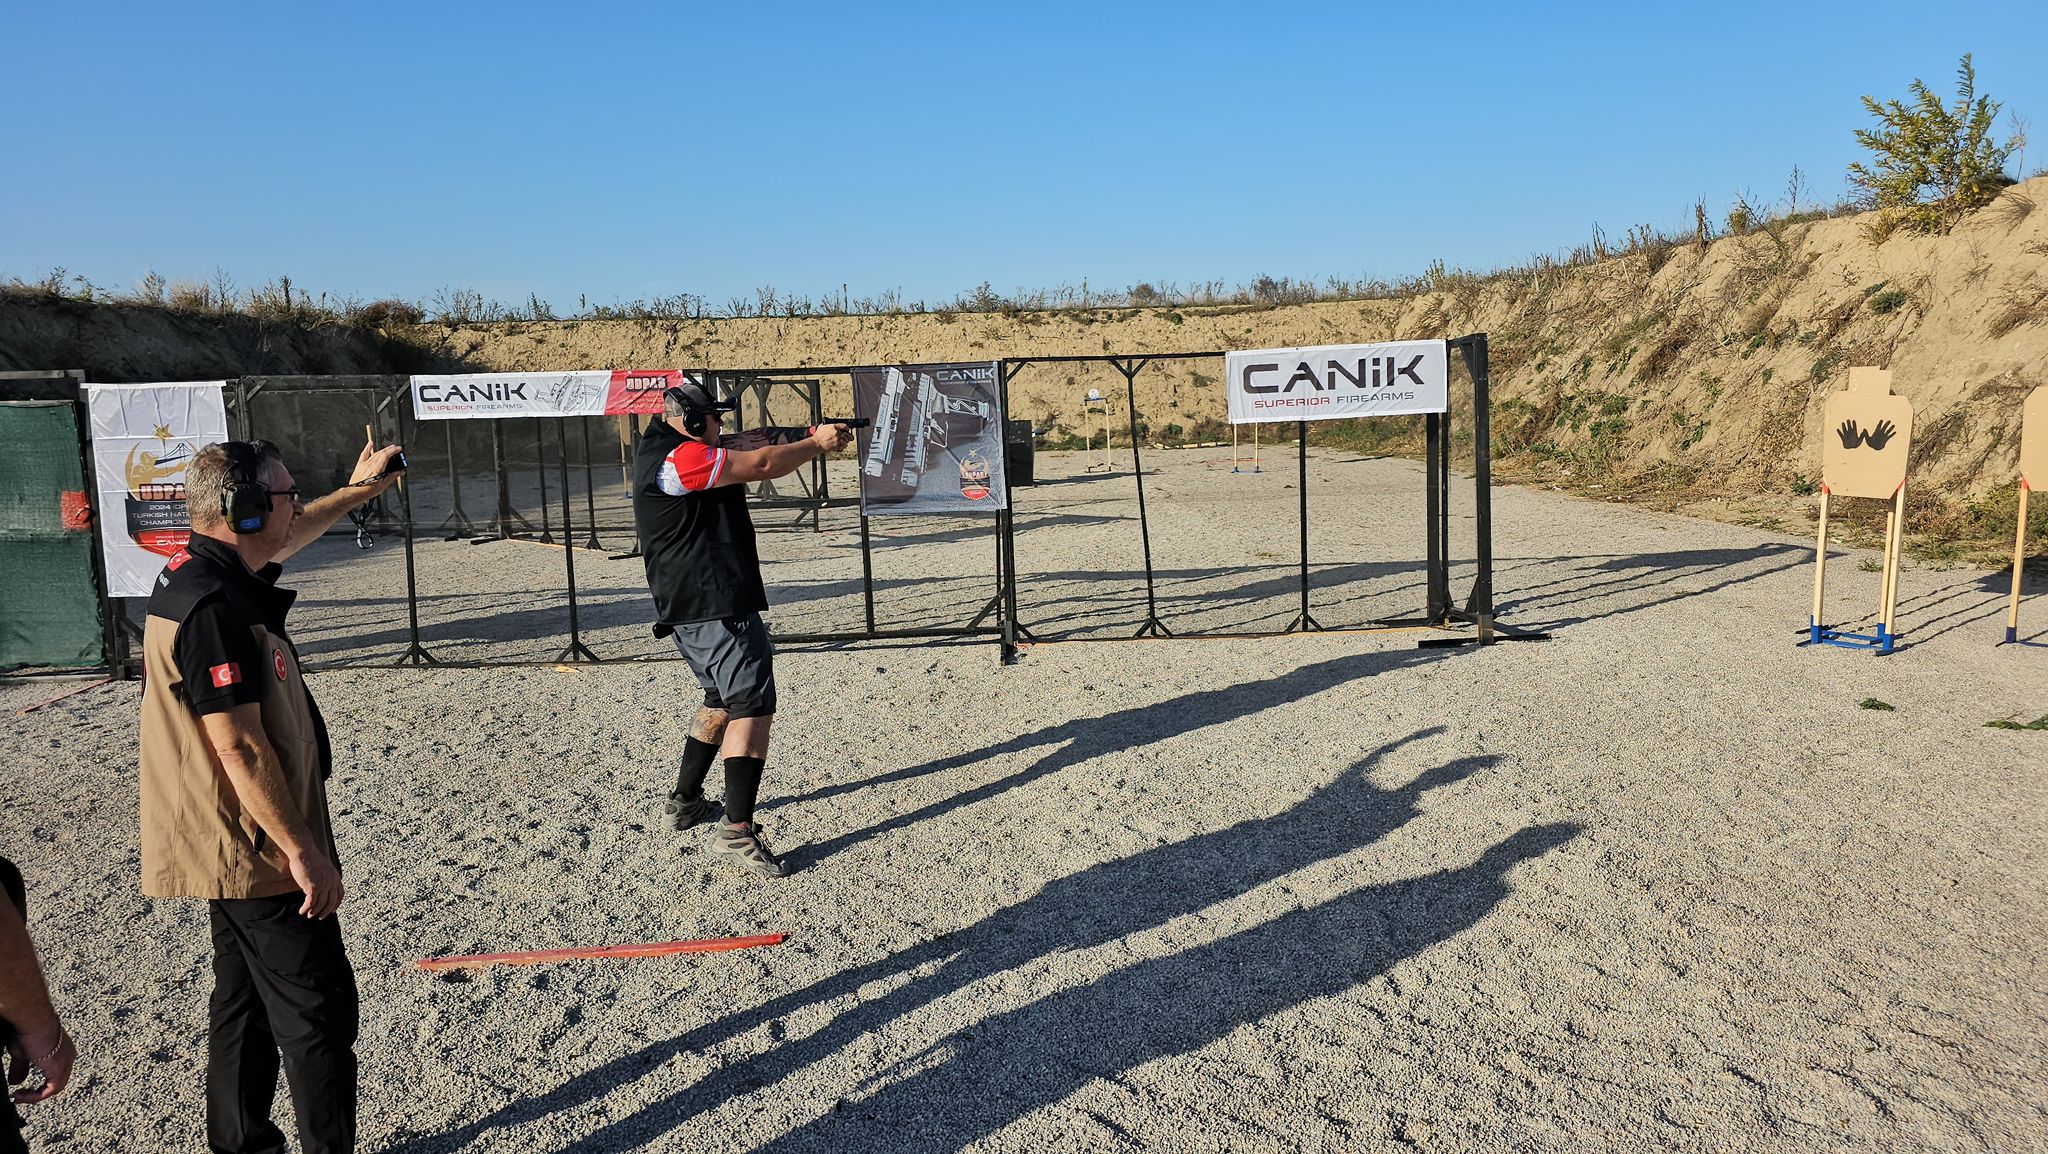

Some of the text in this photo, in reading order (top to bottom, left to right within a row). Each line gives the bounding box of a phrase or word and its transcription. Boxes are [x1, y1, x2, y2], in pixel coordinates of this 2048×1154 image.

[1254, 392, 1414, 409] SUPERIOR FIREARMS
[139, 483, 187, 500] UDPA
